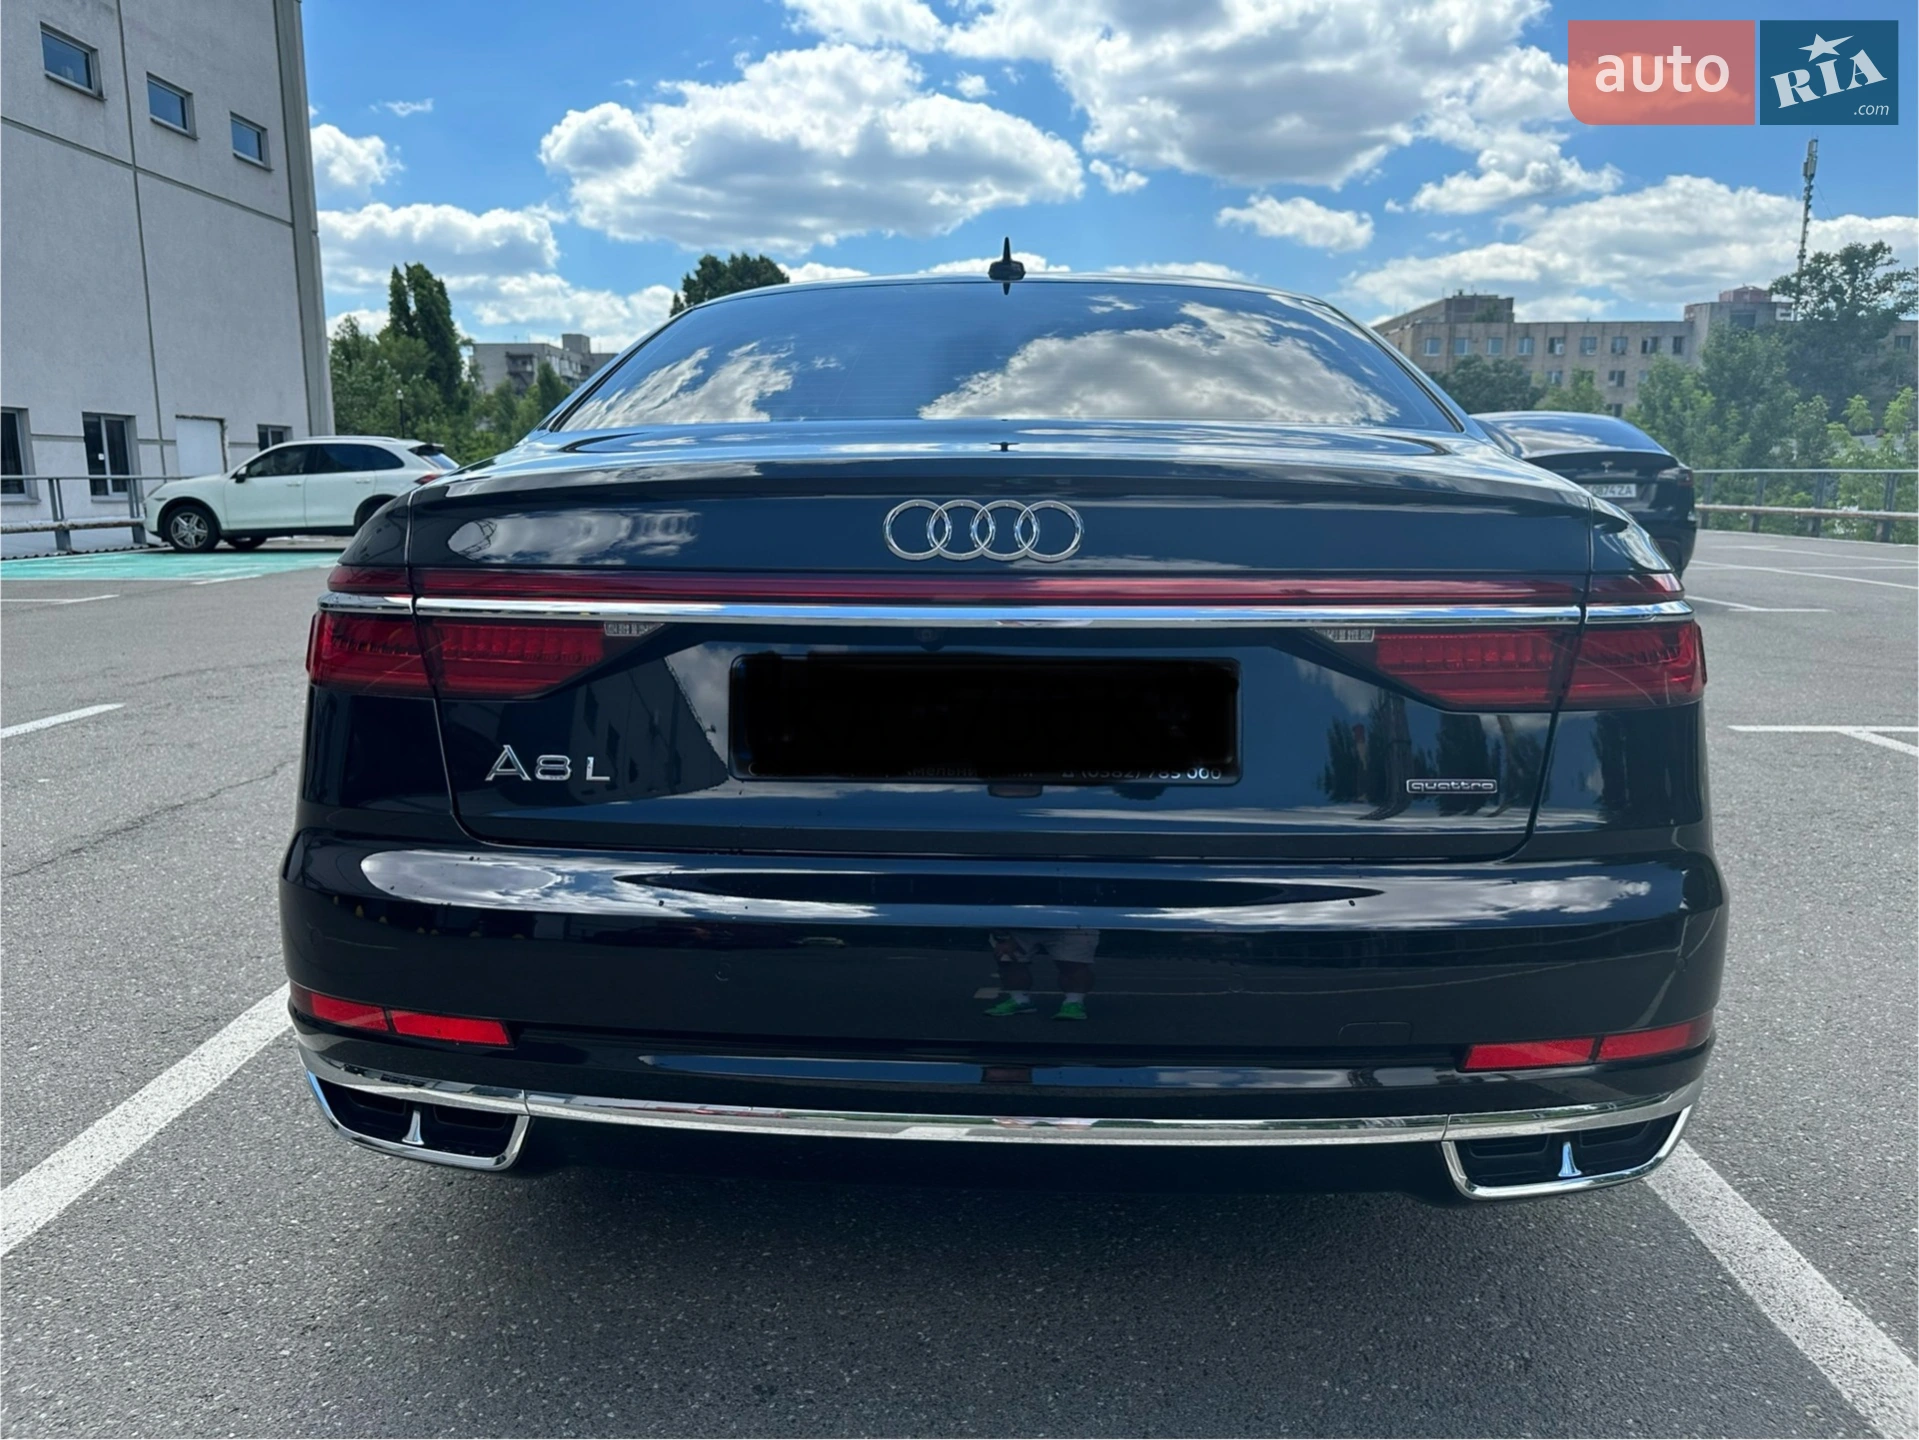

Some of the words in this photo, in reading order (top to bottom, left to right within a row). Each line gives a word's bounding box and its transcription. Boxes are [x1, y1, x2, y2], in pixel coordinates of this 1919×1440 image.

[485, 744, 572, 781] A8
[586, 756, 611, 781] L
[1186, 767, 1222, 780] 000
[1411, 781, 1494, 793] quattro
